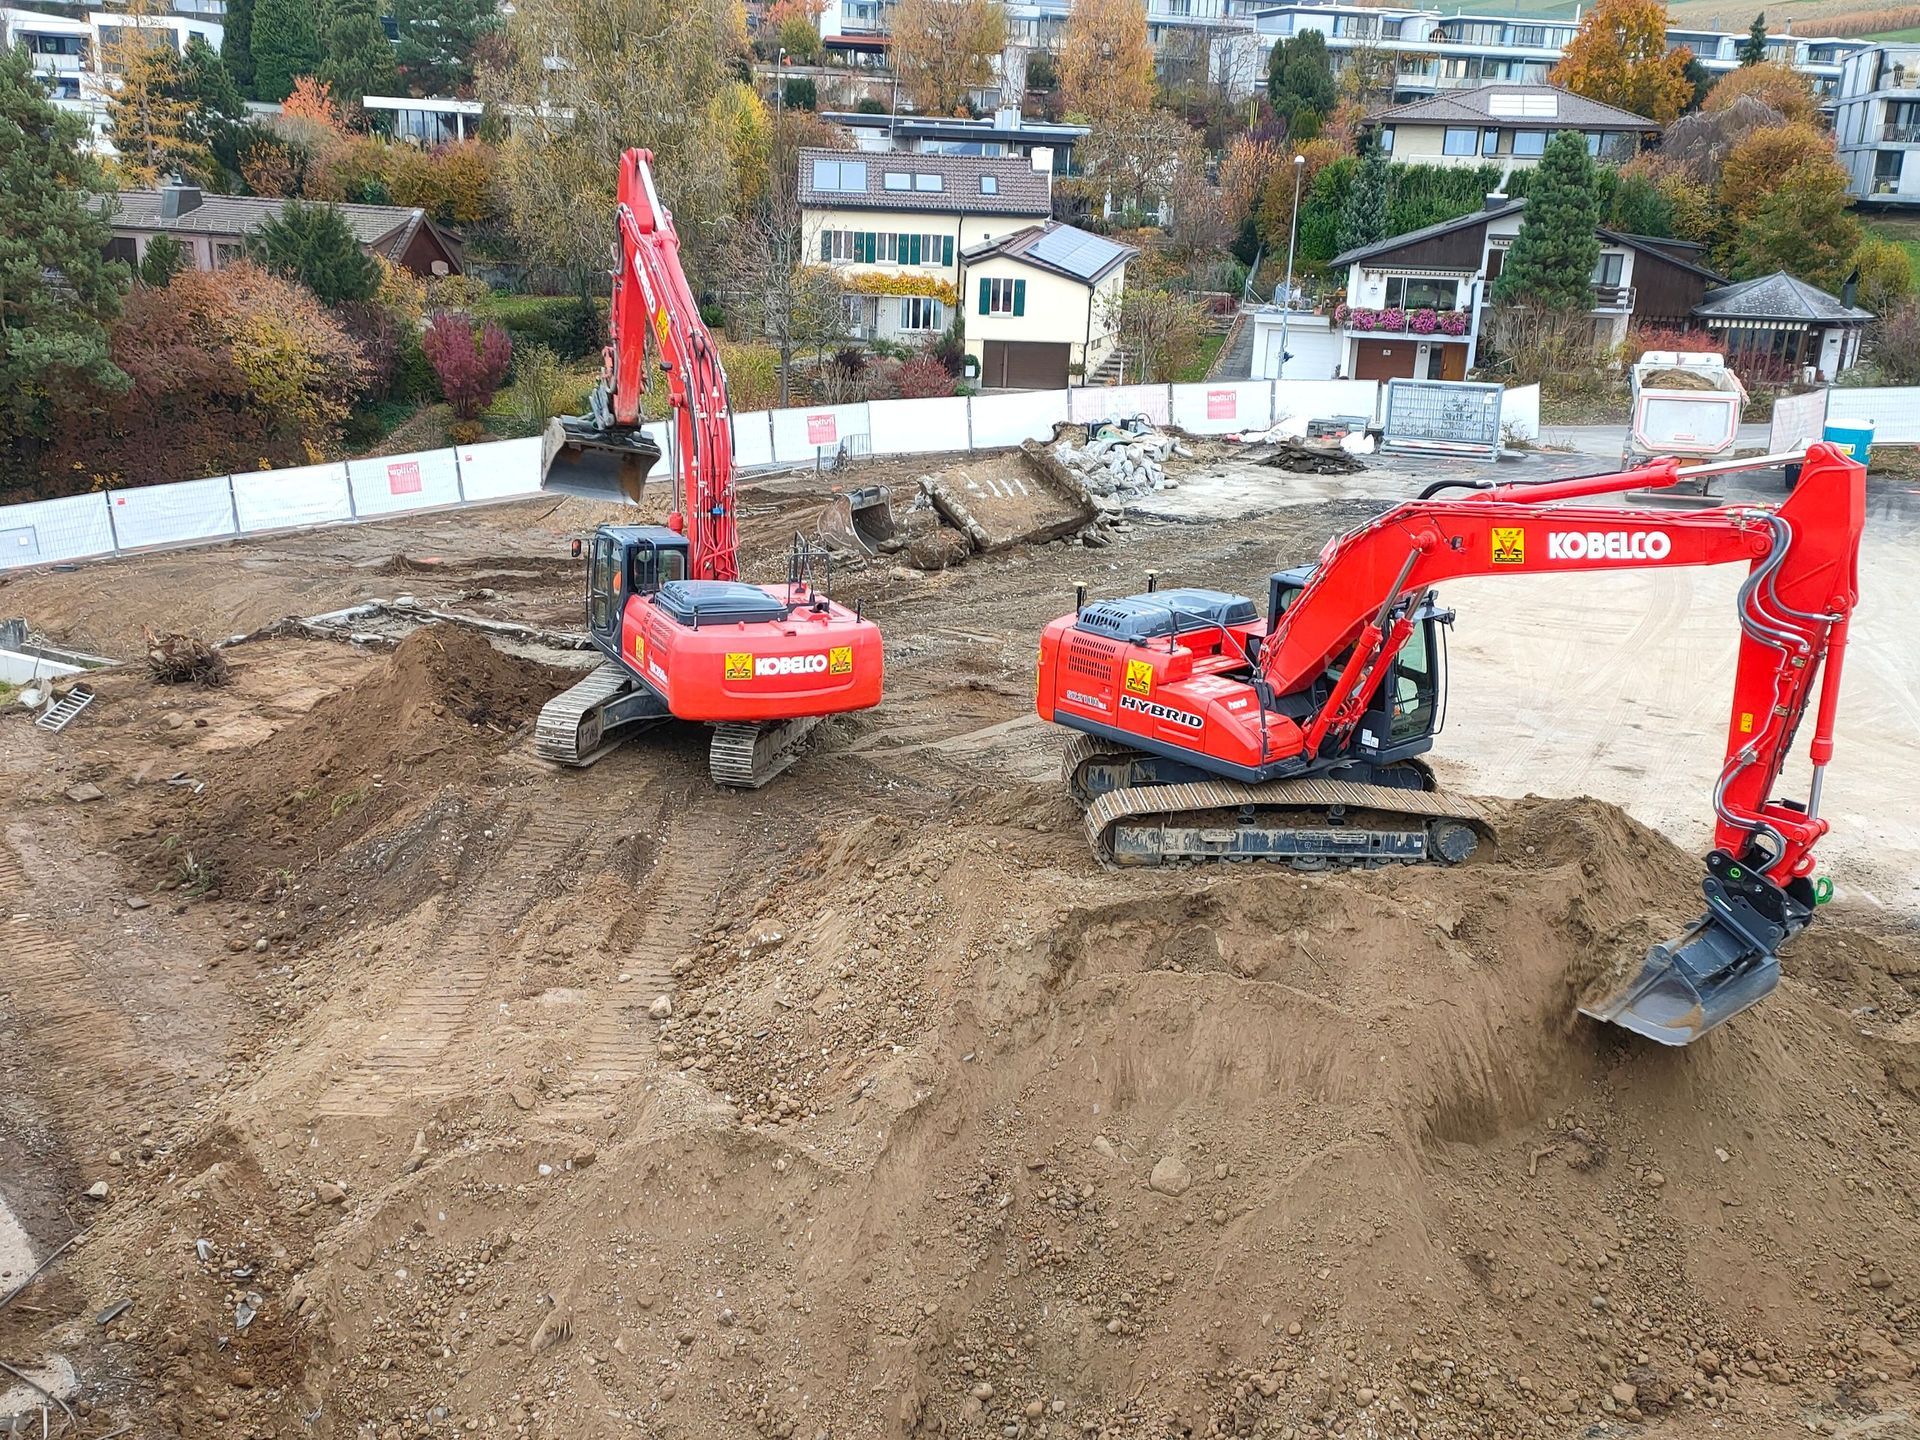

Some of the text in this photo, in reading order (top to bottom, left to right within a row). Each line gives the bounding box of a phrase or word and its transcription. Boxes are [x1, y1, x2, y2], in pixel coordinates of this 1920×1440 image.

[1548, 531, 1671, 560] KOBELCO
[755, 654, 828, 676] KOBELCO
[1120, 694, 1204, 729] HYBRID
